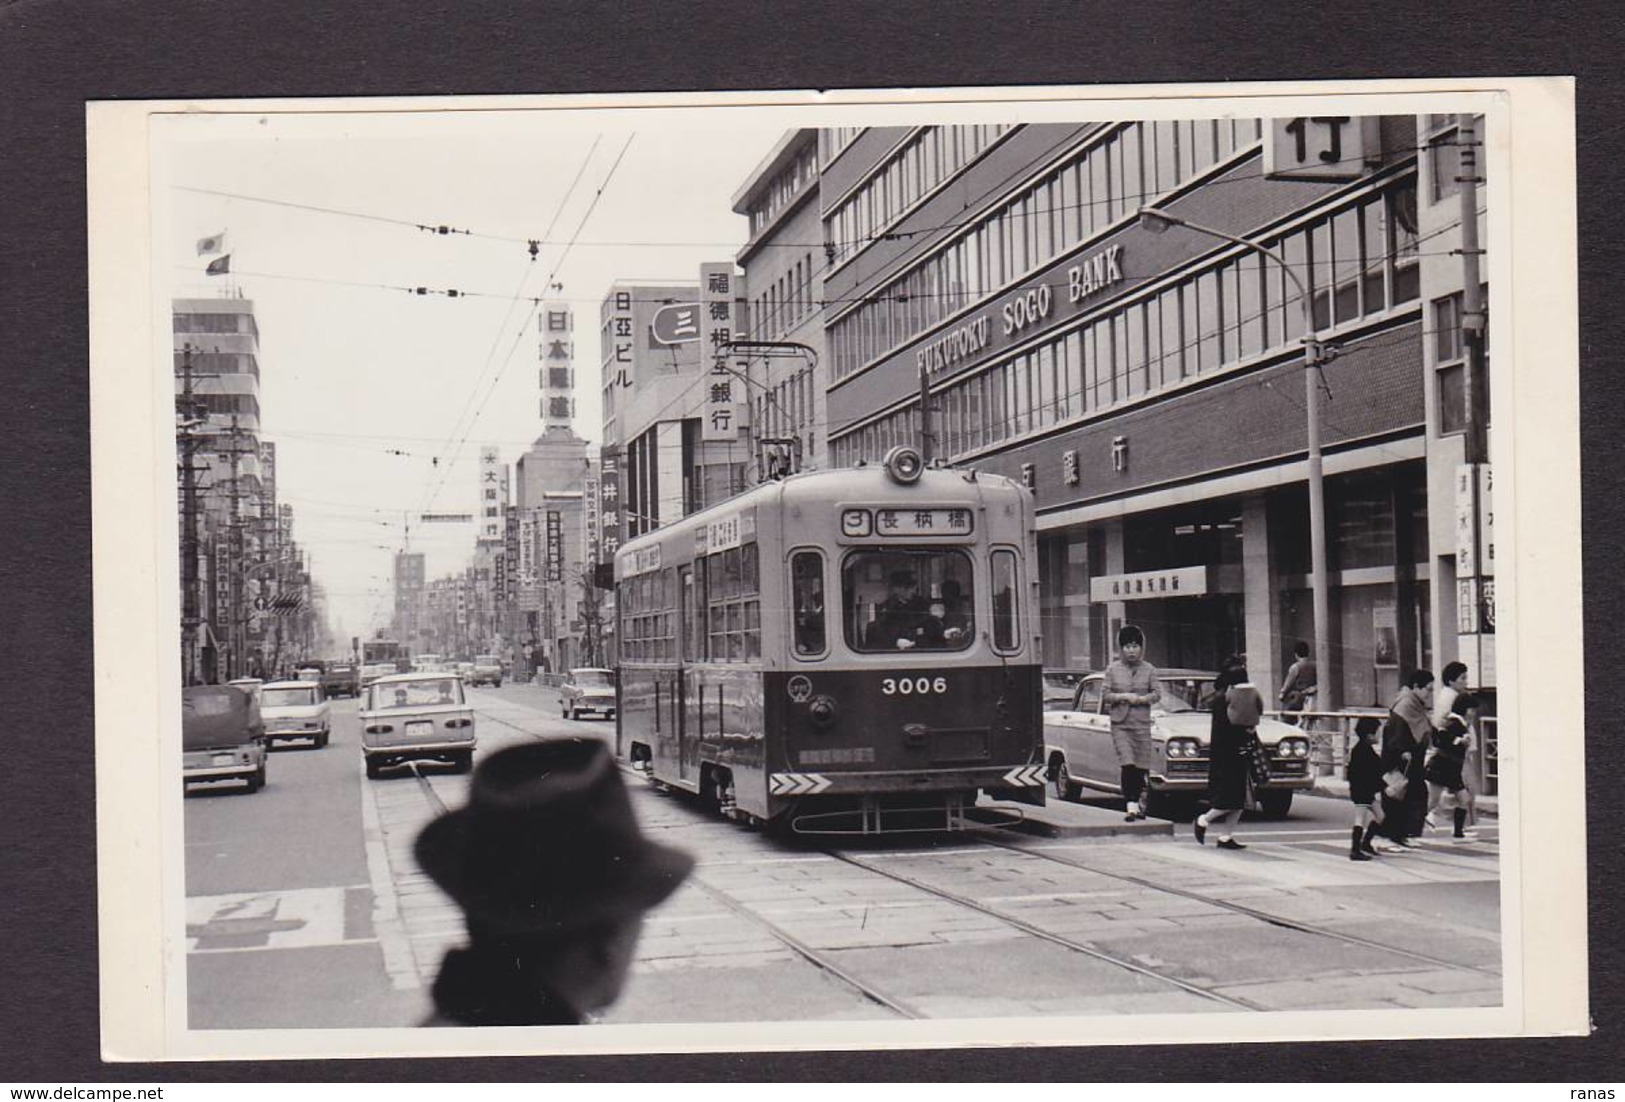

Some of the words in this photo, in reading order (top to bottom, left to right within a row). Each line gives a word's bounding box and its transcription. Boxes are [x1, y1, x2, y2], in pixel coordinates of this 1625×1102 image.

[917, 315, 987, 380] FUKUTOKU
[1003, 284, 1050, 335] SOGO
[1068, 244, 1122, 302] BANK
[602, 460, 620, 553] 三井銀行
[846, 511, 863, 528] 3
[882, 677, 948, 695] 3006
